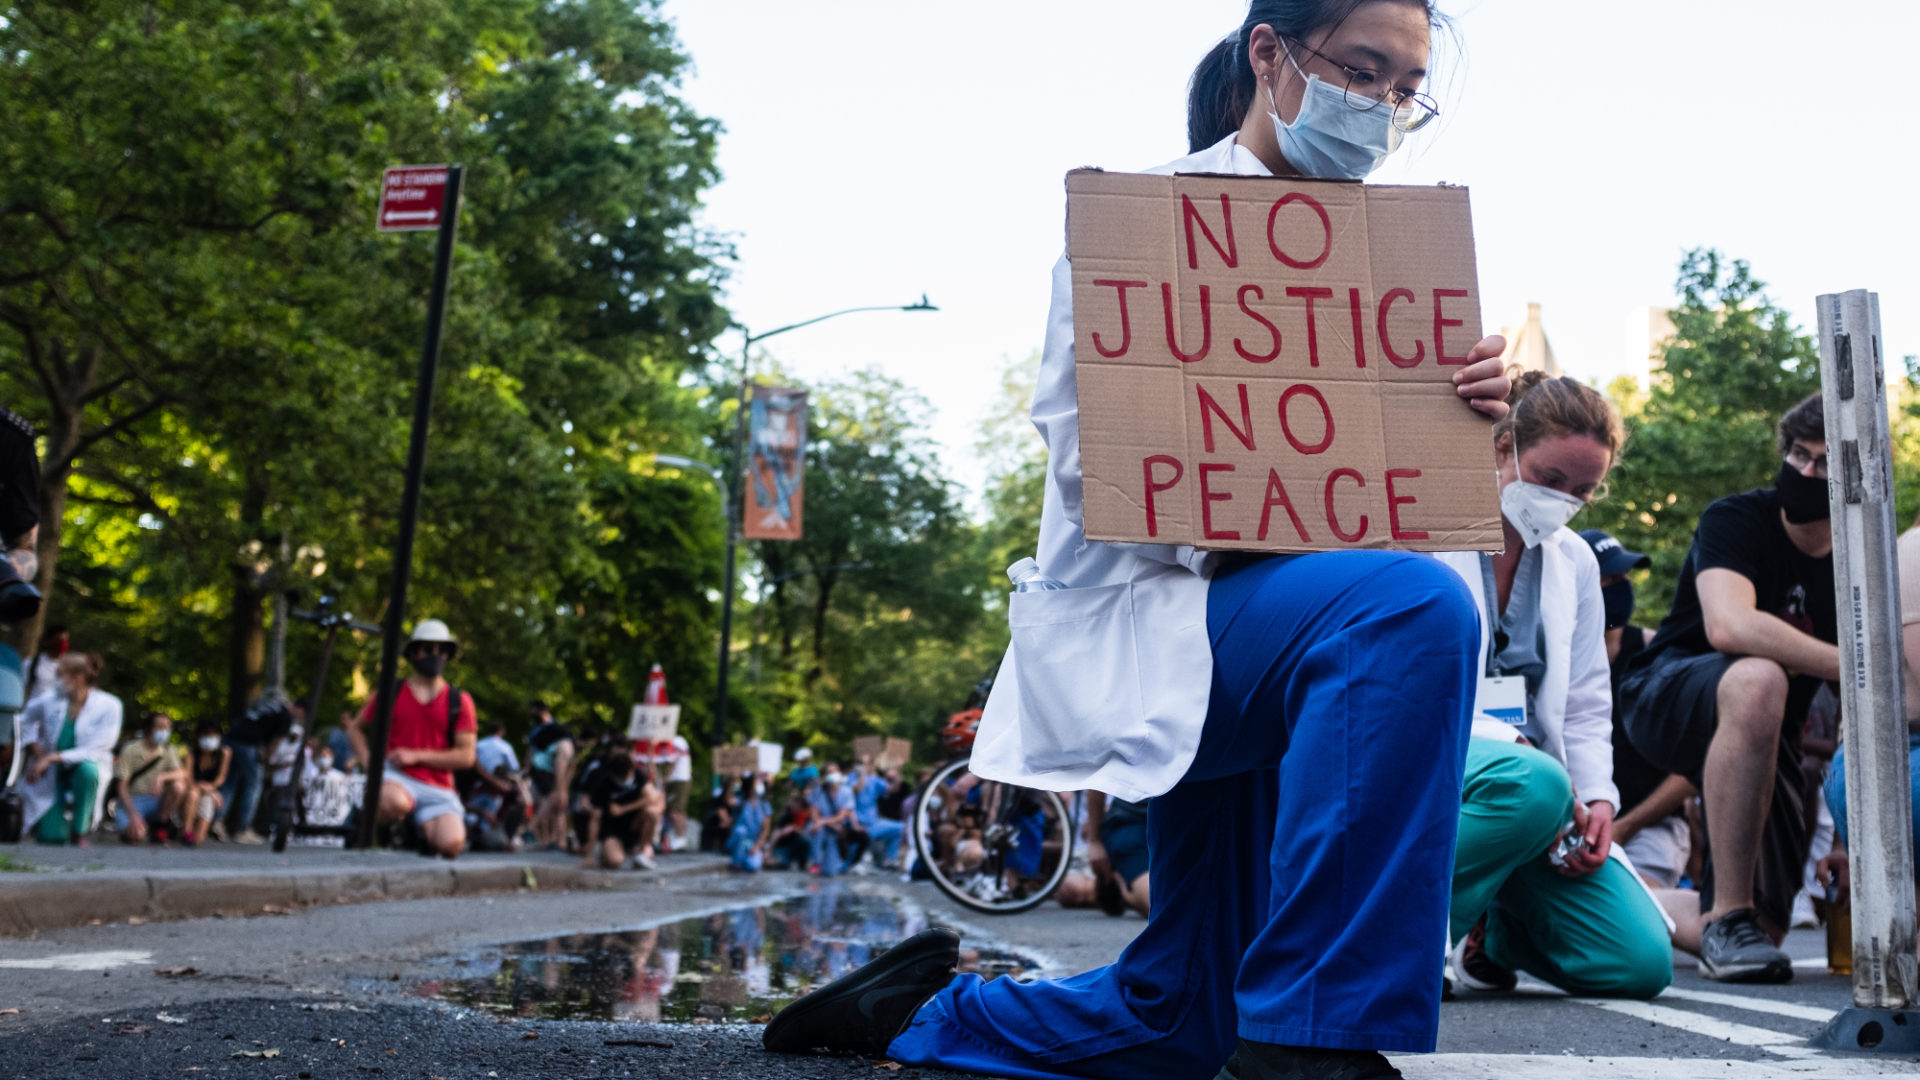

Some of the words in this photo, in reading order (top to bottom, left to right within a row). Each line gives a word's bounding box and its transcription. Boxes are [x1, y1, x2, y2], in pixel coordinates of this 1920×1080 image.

[388, 173, 402, 186] NO
[405, 172, 447, 186] STANDIN
[1181, 191, 1332, 270] NO
[1091, 279, 1469, 368] JUSTICE
[1195, 382, 1335, 455] NO
[1142, 454, 1430, 543] PEACE
